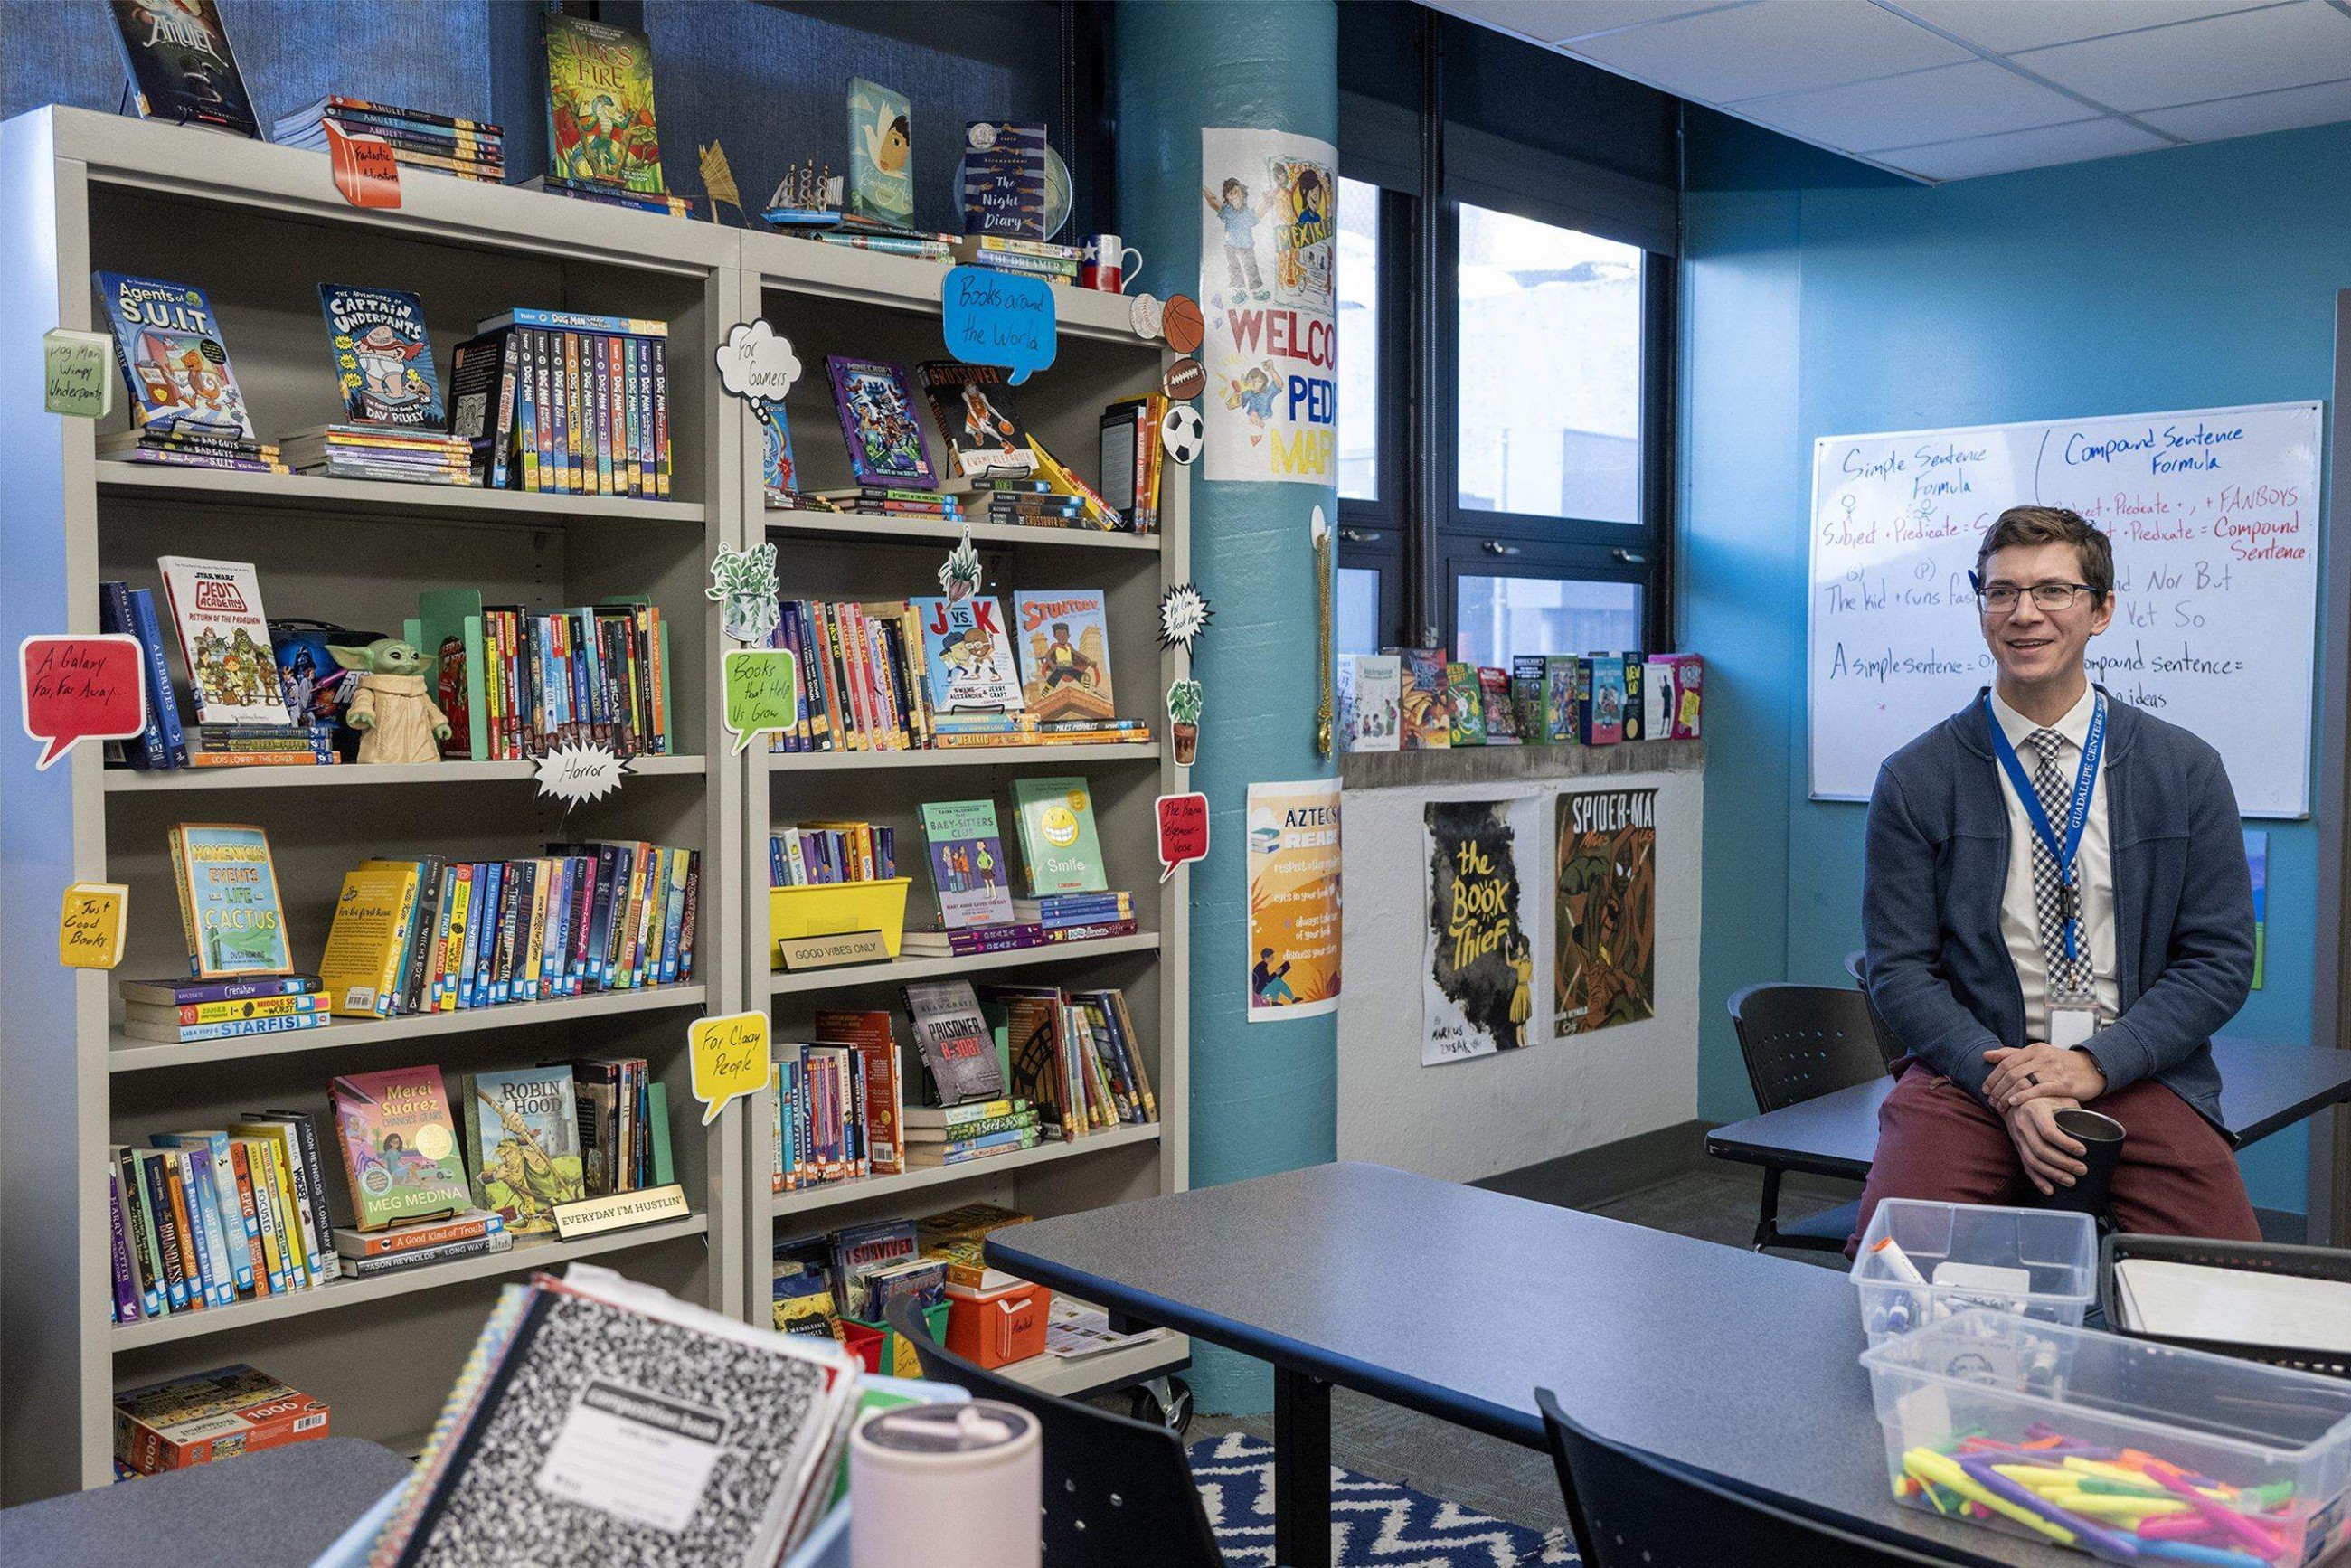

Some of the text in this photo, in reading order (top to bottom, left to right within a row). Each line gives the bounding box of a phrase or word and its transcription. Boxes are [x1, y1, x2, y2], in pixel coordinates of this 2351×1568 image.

[143, 14, 226, 63] AMULET
[564, 32, 633, 67] WINGS
[578, 59, 626, 89] FIRE
[355, 146, 390, 162] Fantastic
[982, 193, 1018, 210] Night
[985, 217, 1022, 230] Diary
[119, 282, 174, 302] Agents
[175, 294, 184, 302] of
[959, 275, 1002, 307] Books
[119, 297, 213, 336] S.U.I.T.
[333, 316, 423, 340] UNDERPANTS
[738, 331, 758, 361] For
[963, 320, 1039, 351] the World
[1227, 308, 1337, 366] WELCO
[76, 346, 101, 360] Man
[60, 364, 92, 382] Wimpy
[749, 360, 788, 386] Gamers
[847, 362, 892, 375] MINECRAFT
[929, 366, 998, 387] CROSSOVER
[1289, 375, 1337, 425] PED
[2066, 424, 2244, 466] Compound Sentence
[992, 452, 1030, 466] ALEXANDER
[1843, 443, 1987, 481] Simple Sentence
[2152, 449, 2222, 476] Formula
[1913, 468, 1972, 500] Formula
[2220, 484, 2299, 514] FANBOYS
[1822, 515, 1960, 548] Subject Predicate
[2214, 511, 2299, 543] Compound
[2231, 538, 2306, 562] Sentence
[194, 571, 234, 581] STAR WARS
[2114, 561, 2233, 591] nd Nor But
[202, 581, 232, 598] JEDI
[1825, 583, 1856, 614] The
[1863, 578, 1886, 609] kid
[200, 597, 241, 609] ACADEMY
[2127, 600, 2205, 628] Yet So
[189, 612, 260, 625] RETURN OF THE PADAWAN
[930, 600, 1000, 635] J VS. K
[37, 645, 107, 677] A Galaxy
[735, 655, 775, 681] Books
[1626, 665, 1641, 679] NEW
[1830, 642, 1847, 679] A
[1853, 647, 1899, 683] simple
[1903, 648, 1962, 675] sentence
[2083, 640, 2235, 679] ompound sentence
[33, 677, 54, 699] Far,
[57, 677, 74, 695] Far
[153, 643, 174, 711] ALEBRIJES
[745, 680, 789, 699] that Help
[2129, 681, 2167, 708] ideas
[732, 703, 778, 722] Us Grow
[559, 757, 608, 783] Horror
[2072, 761, 2093, 829] GUADALUPE
[2088, 717, 2103, 760] CENTERS
[930, 817, 994, 831] BABY-SITTERS
[1284, 806, 1336, 827] AZTECS
[1572, 792, 1655, 834] SPIDER-MA
[1284, 830, 1336, 848] READ!
[1047, 858, 1086, 874] Smile
[1458, 840, 1495, 875] the
[209, 868, 260, 883] EVENTS
[82, 900, 111, 915] Just
[225, 888, 253, 904] LIFE
[65, 915, 98, 930] Good
[204, 908, 277, 930] CACTUS
[70, 930, 107, 949] Books
[418, 928, 429, 959] WITCH'S
[558, 917, 569, 949] SOAR
[984, 929, 1015, 939] DRAMA
[987, 940, 1017, 949] DRAMA
[1449, 918, 1510, 970] Thief
[436, 942, 447, 974] DIVIDED
[796, 942, 877, 959] GOOD VIBES ONLY
[224, 985, 256, 998] Crenshaw
[257, 999, 285, 1008] MIDDLE
[703, 1022, 724, 1050] For
[928, 1017, 982, 1041] PRISONER
[1431, 1025, 1463, 1041] MARKUS
[940, 1037, 982, 1061] B-3087
[1440, 1038, 1472, 1055] ZUSAK
[713, 1050, 751, 1080] People
[387, 1081, 433, 1100] Merci
[503, 1080, 562, 1100] ROBIN
[382, 1099, 439, 1116] Suárez
[514, 1096, 563, 1115] HOOD
[382, 1111, 443, 1128] CHANGES GEARS
[293, 1167, 307, 1203] WORSER
[305, 1123, 332, 1248] JASON REYNOLDS LONG WAY
[257, 1189, 271, 1233] FOCUSED
[368, 1187, 463, 1213] MEG MEDINA
[562, 1195, 682, 1226] EVERYDAY I'M HUSTLIN'
[110, 1197, 130, 1281] HARRY POTTER
[397, 1227, 457, 1247] A Good Kind of
[845, 1237, 913, 1263] I SURVIVED
[160, 1223, 184, 1285] BOUNDLESS
[364, 1243, 484, 1271] JASON REYNOLDS LONG WAY
[789, 1322, 826, 1333] MADELEINE
[246, 1401, 298, 1420] 1000
[146, 1435, 156, 1471] 1000
